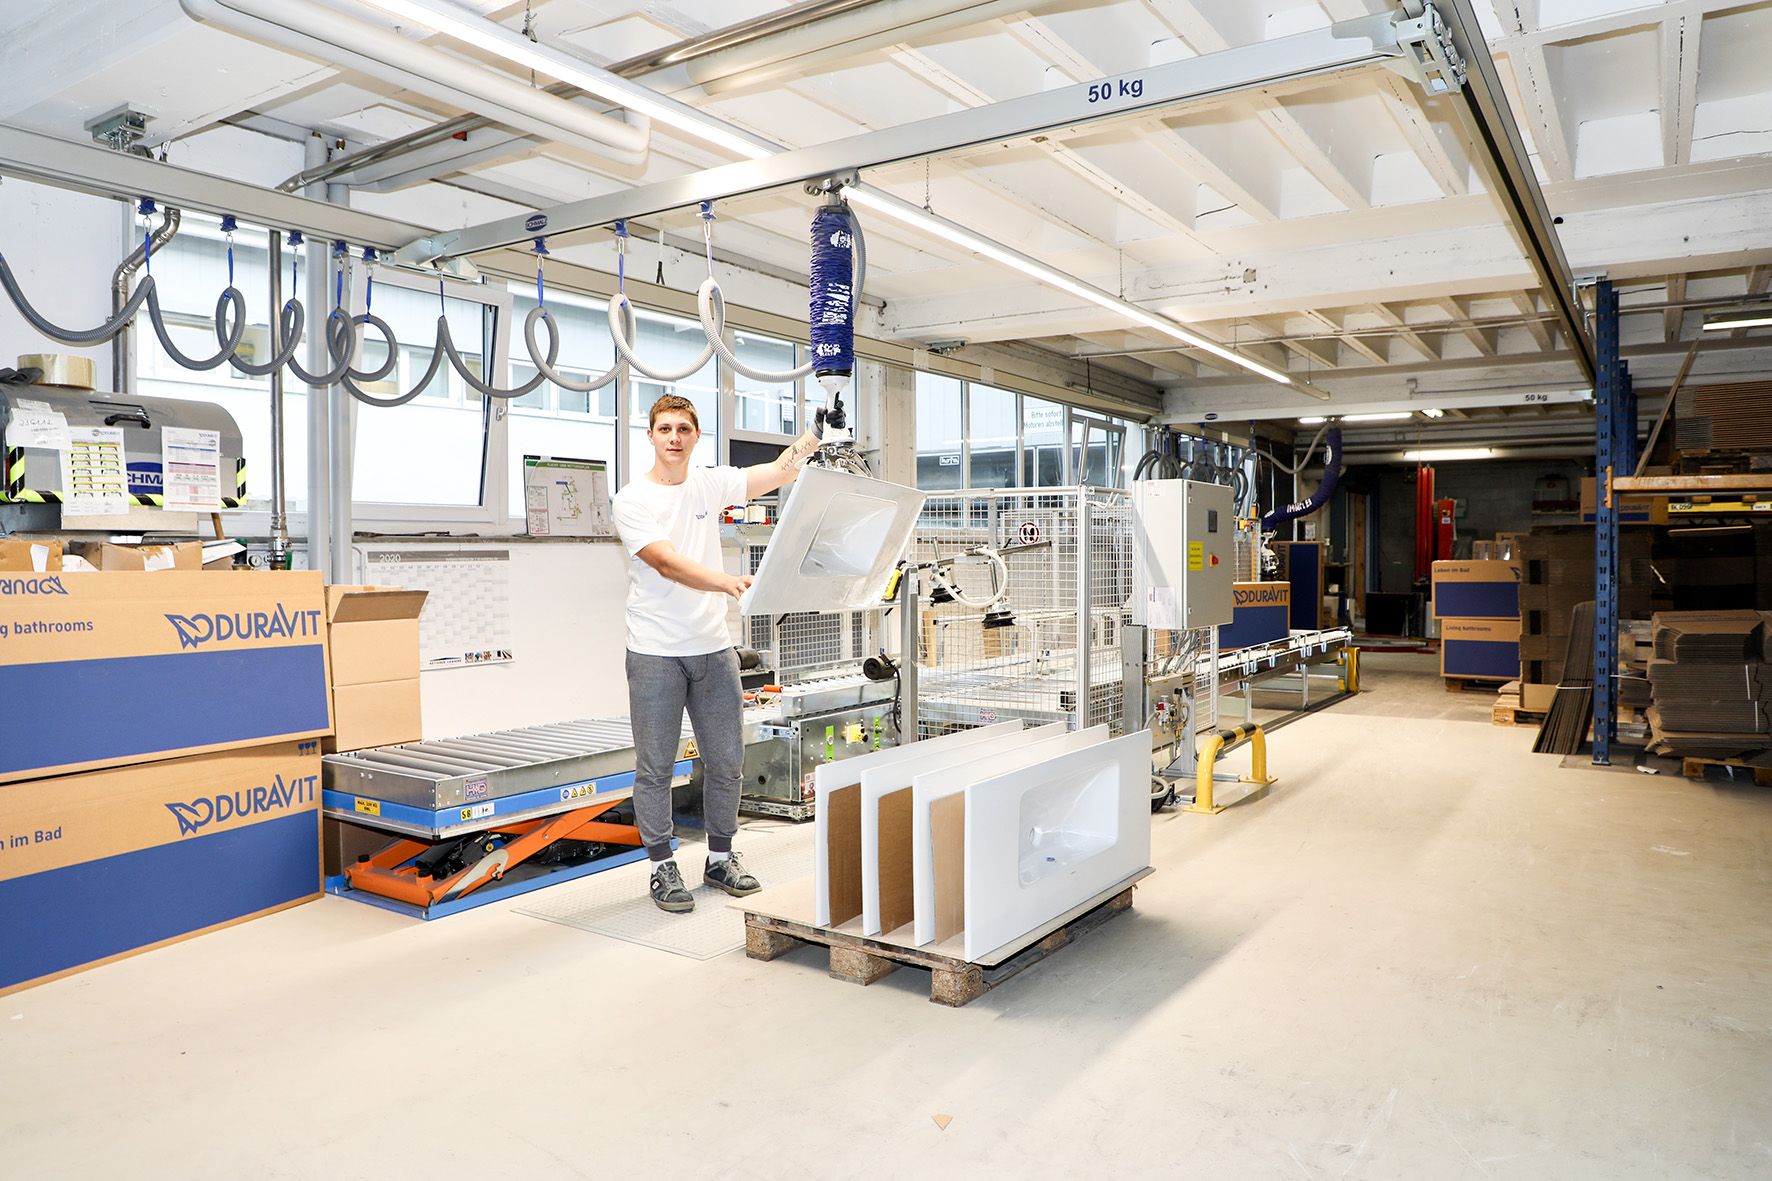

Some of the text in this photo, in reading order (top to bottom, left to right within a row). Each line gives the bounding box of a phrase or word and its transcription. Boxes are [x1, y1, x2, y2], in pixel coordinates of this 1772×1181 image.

[1088, 79, 1143, 103] 50 kg
[1536, 394, 1548, 402] kg
[379, 554, 401, 564] 2020
[0, 579, 38, 594] DUR
[1248, 586, 1288, 603] DURAVIT
[14, 620, 94, 635] bathrooms
[216, 602, 321, 642] DURAVIT
[216, 774, 318, 824] DURAVIT
[10, 835, 29, 848] im
[35, 826, 62, 844] Bad
